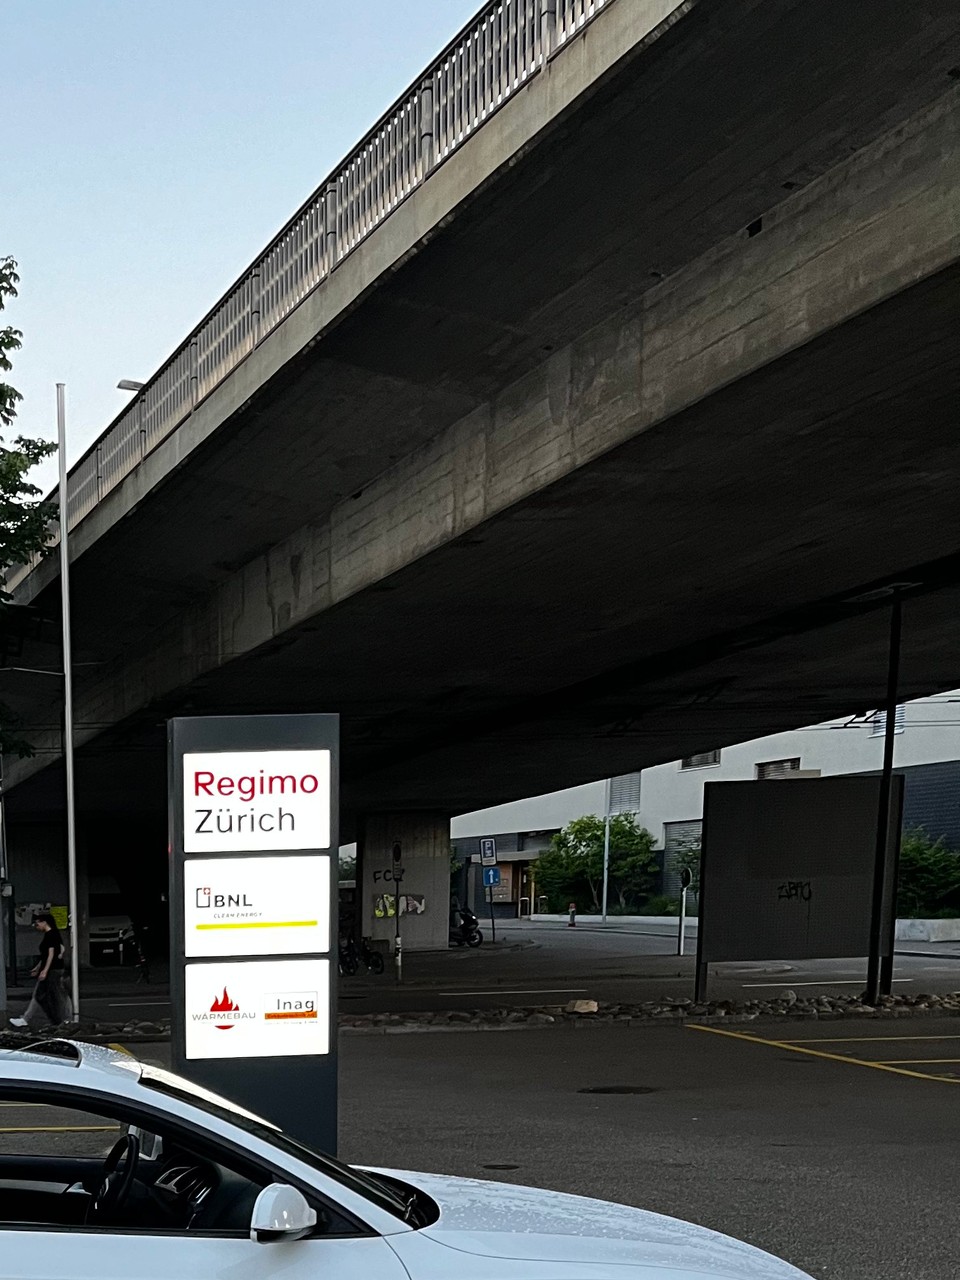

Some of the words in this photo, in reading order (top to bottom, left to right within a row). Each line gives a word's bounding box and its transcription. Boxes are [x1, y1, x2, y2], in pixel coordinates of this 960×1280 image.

[194, 769, 319, 802] Regimo
[195, 807, 295, 834] Zürich
[214, 894, 253, 908] BNL
[277, 998, 314, 1013] Inag
